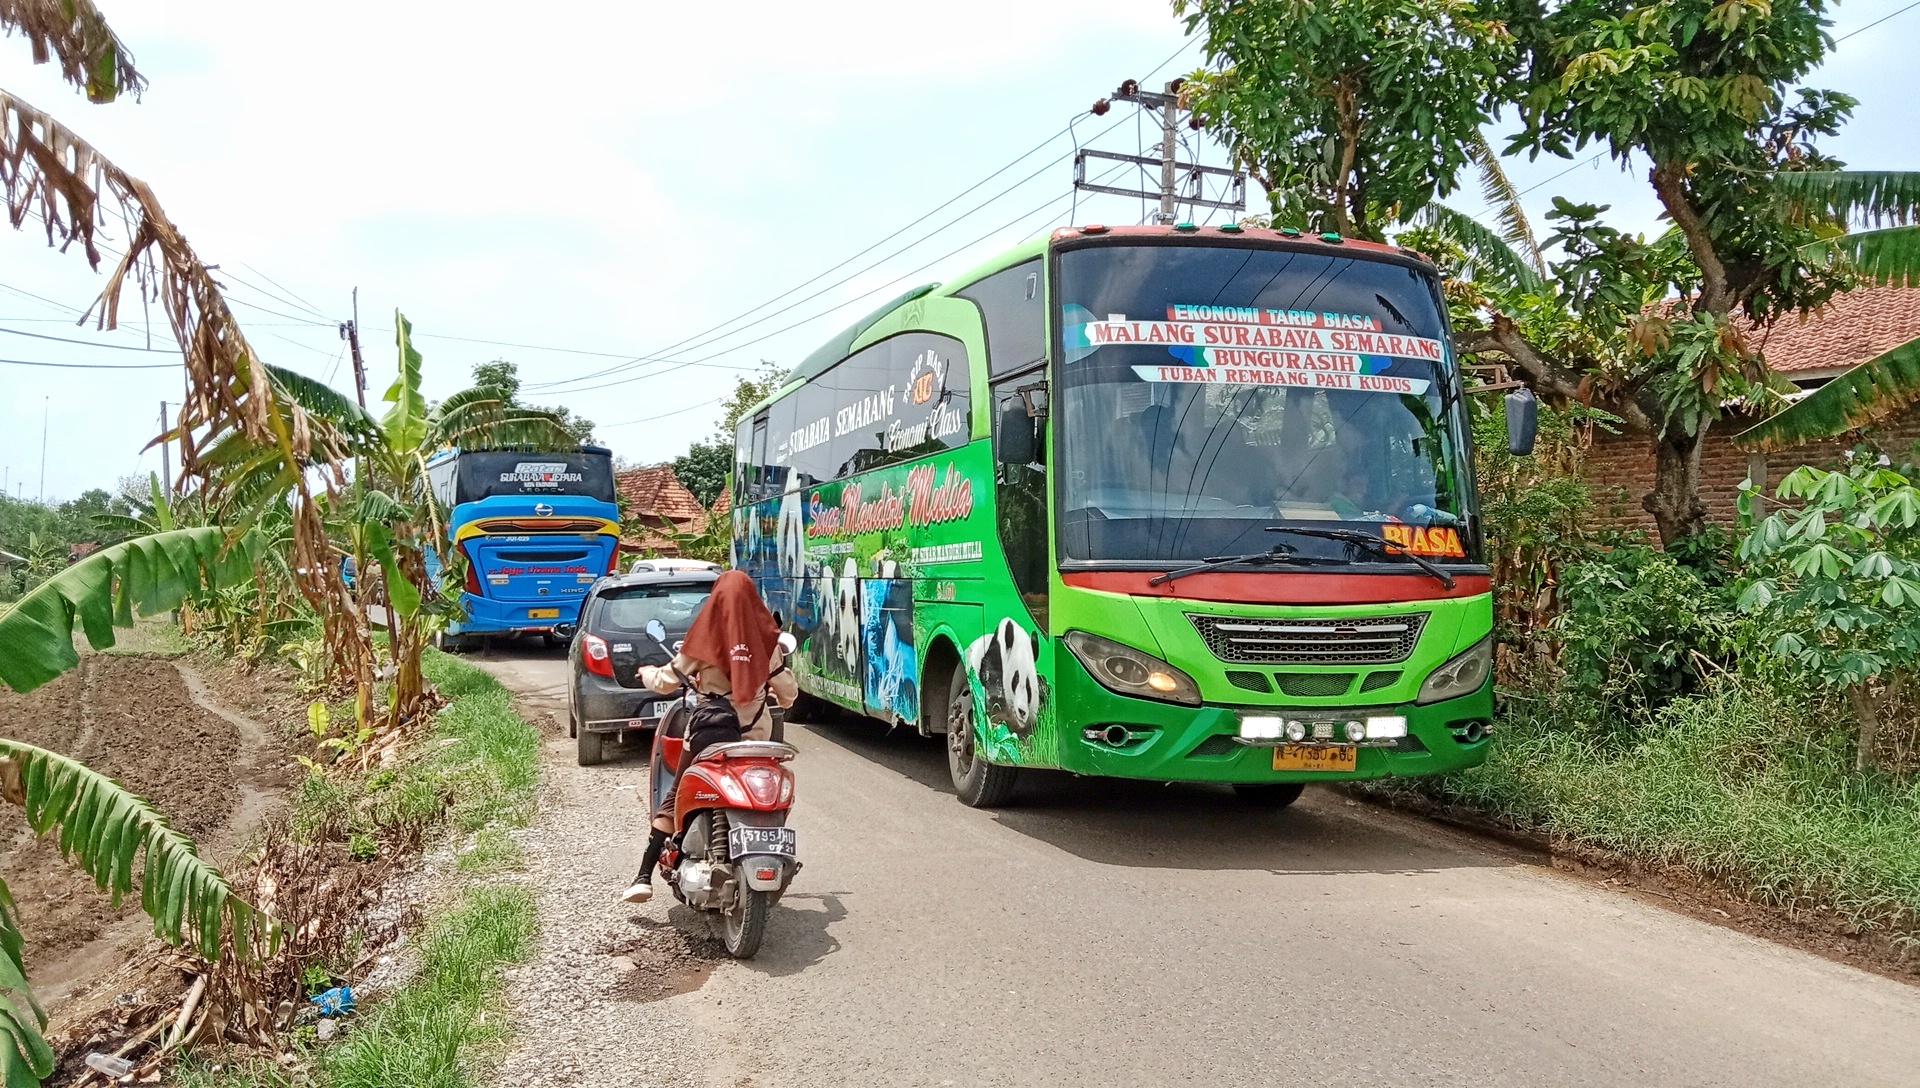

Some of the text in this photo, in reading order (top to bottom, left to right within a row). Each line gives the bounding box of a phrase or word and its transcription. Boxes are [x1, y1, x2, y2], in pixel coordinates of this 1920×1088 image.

[1174, 304, 1377, 331] EKONOMI TARIP BIASA
[1094, 323, 1441, 361] MALANG SURABAYA SEMARANG
[1213, 348, 1356, 373] BUNGURASIH
[1158, 366, 1412, 393] TUBAN REMBANG PATI KUDUS
[789, 416, 830, 456] SURABAYA
[835, 384, 895, 437] SEMARANG
[929, 401, 962, 440] Class
[500, 473, 582, 482] SURABAYA JEPARA
[907, 461, 974, 527] Mulia
[1382, 524, 1466, 557] BIASA
[732, 831, 741, 846] K
[746, 830, 776, 842] 5795
